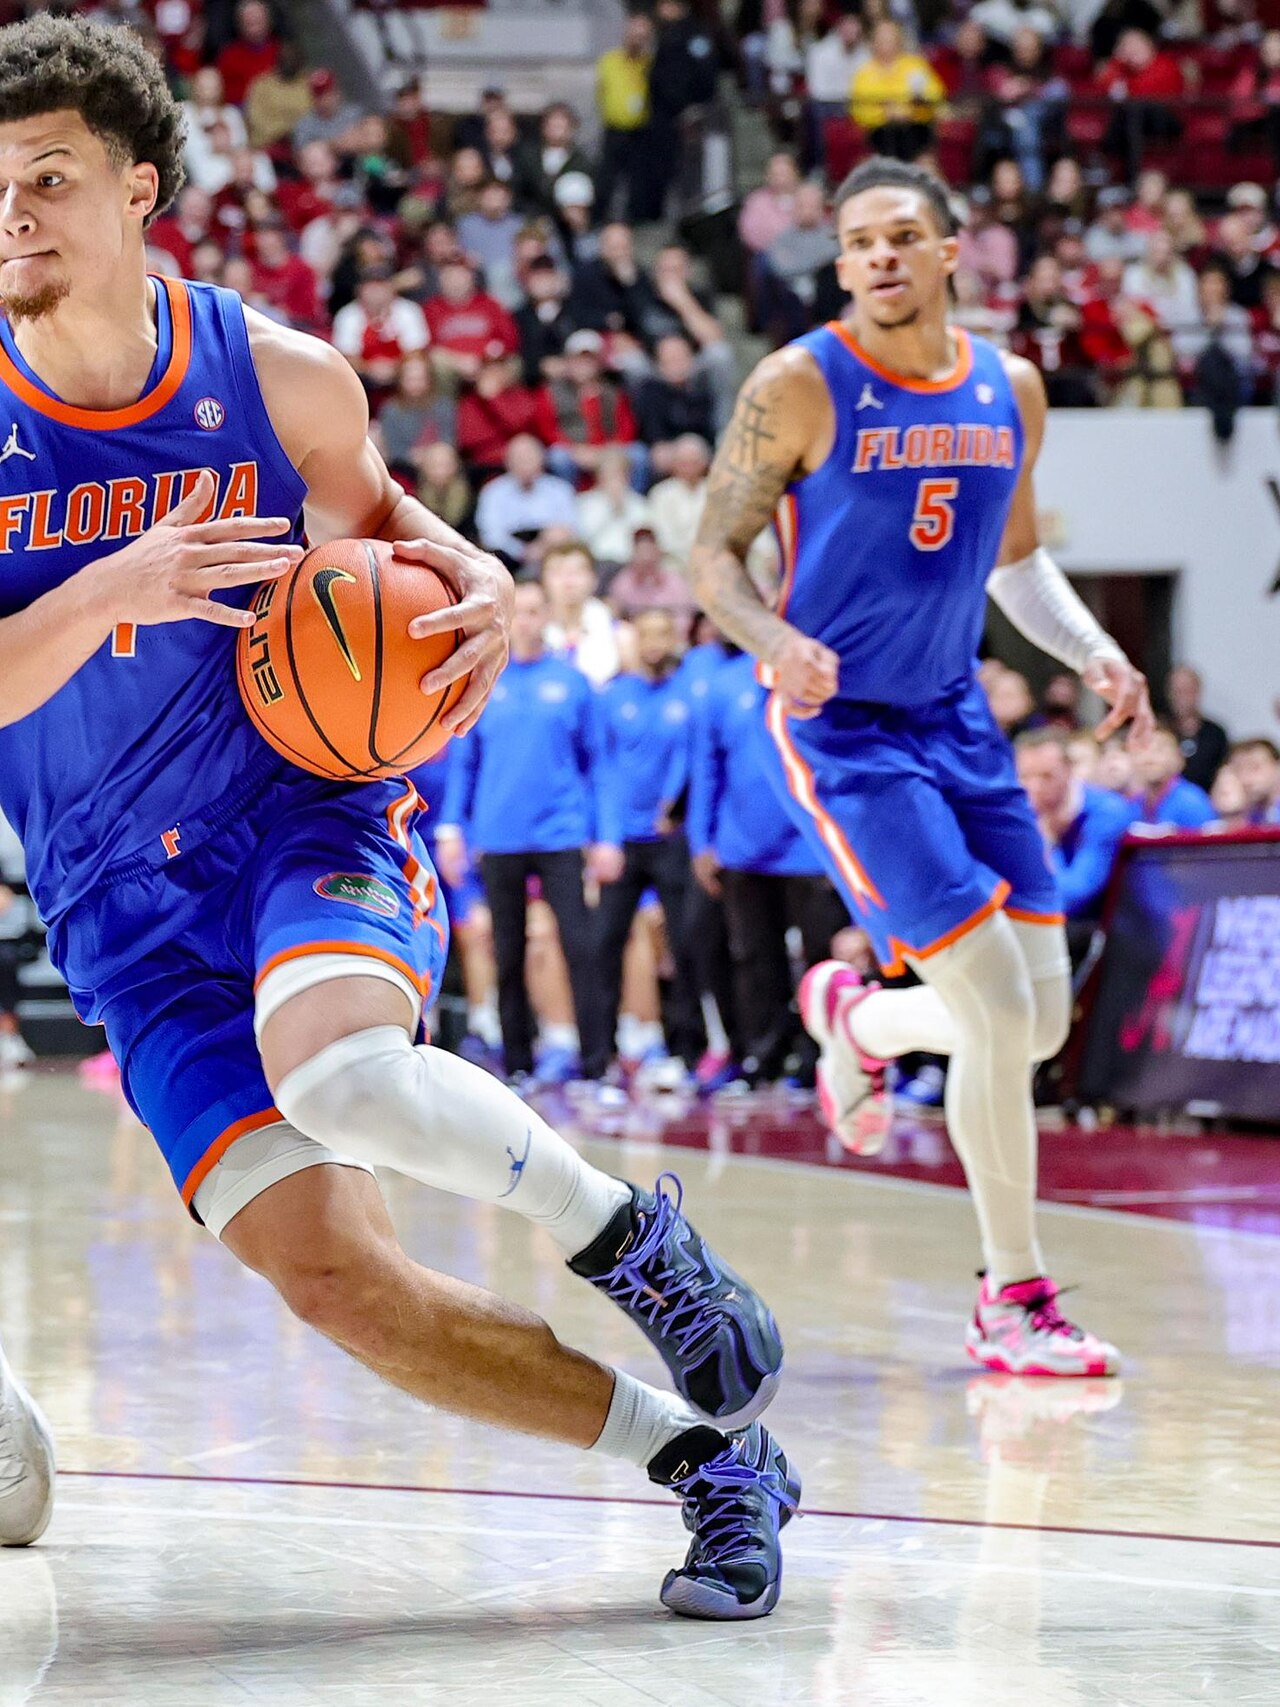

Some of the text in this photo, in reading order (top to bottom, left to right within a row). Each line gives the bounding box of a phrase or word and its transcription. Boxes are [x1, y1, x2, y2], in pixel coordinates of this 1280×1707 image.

[196, 399, 223, 429] SEC
[851, 422, 1015, 474] FLORIDA
[908, 476, 960, 552] 5
